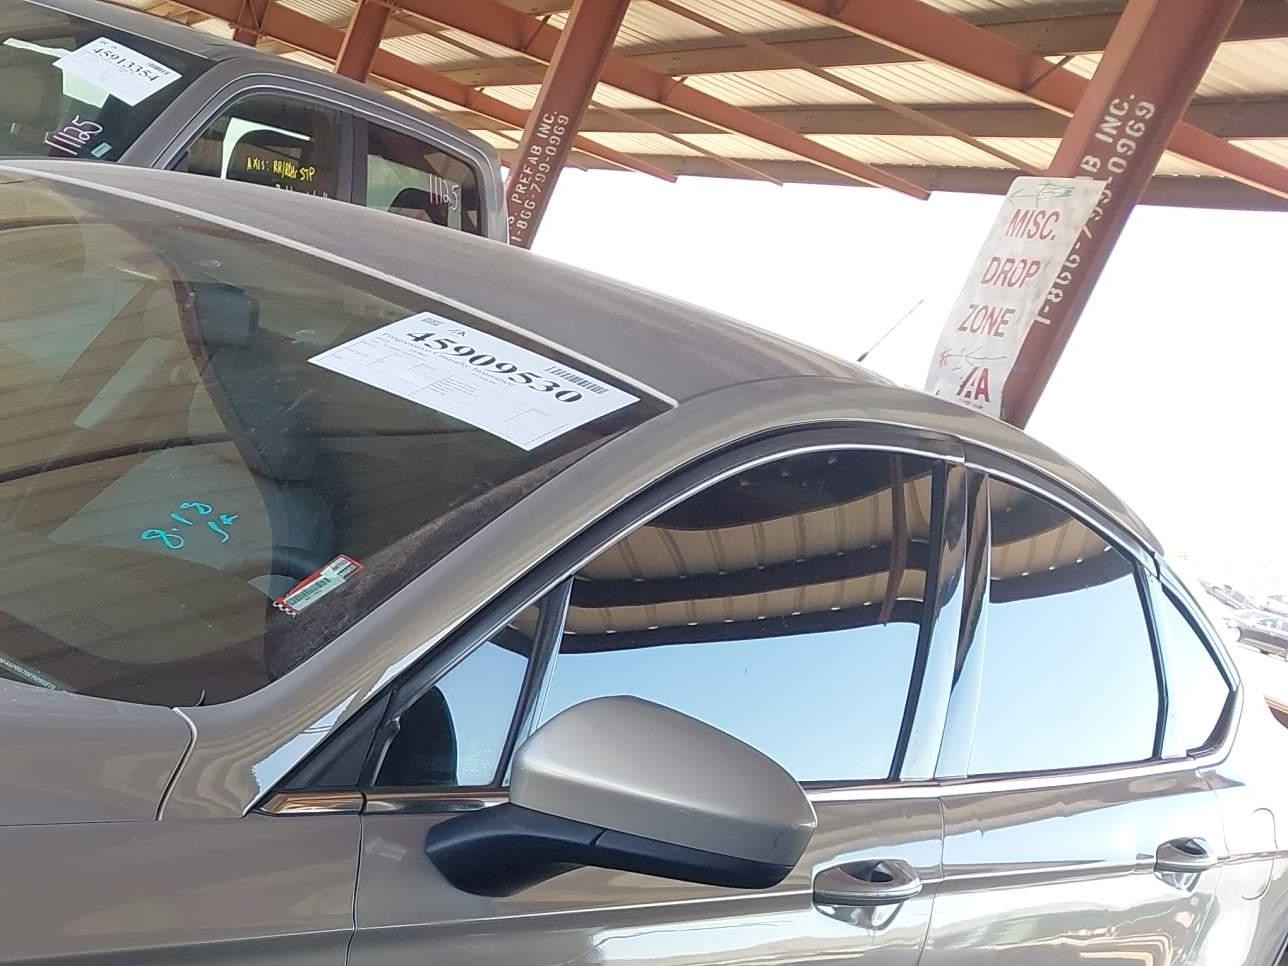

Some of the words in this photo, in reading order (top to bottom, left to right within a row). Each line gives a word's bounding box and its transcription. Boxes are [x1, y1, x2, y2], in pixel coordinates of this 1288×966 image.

[93, 47, 160, 82] 45913354
[1095, 94, 1135, 143] INC.
[511, 114, 569, 242] 1-866-799-0969
[512, 144, 542, 204] PREFAB
[537, 111, 557, 138] INC.
[1005, 209, 1061, 241] MISC.
[981, 256, 1041, 288] DROP
[957, 303, 1016, 338] ZONE
[406, 331, 583, 402] 45909530
